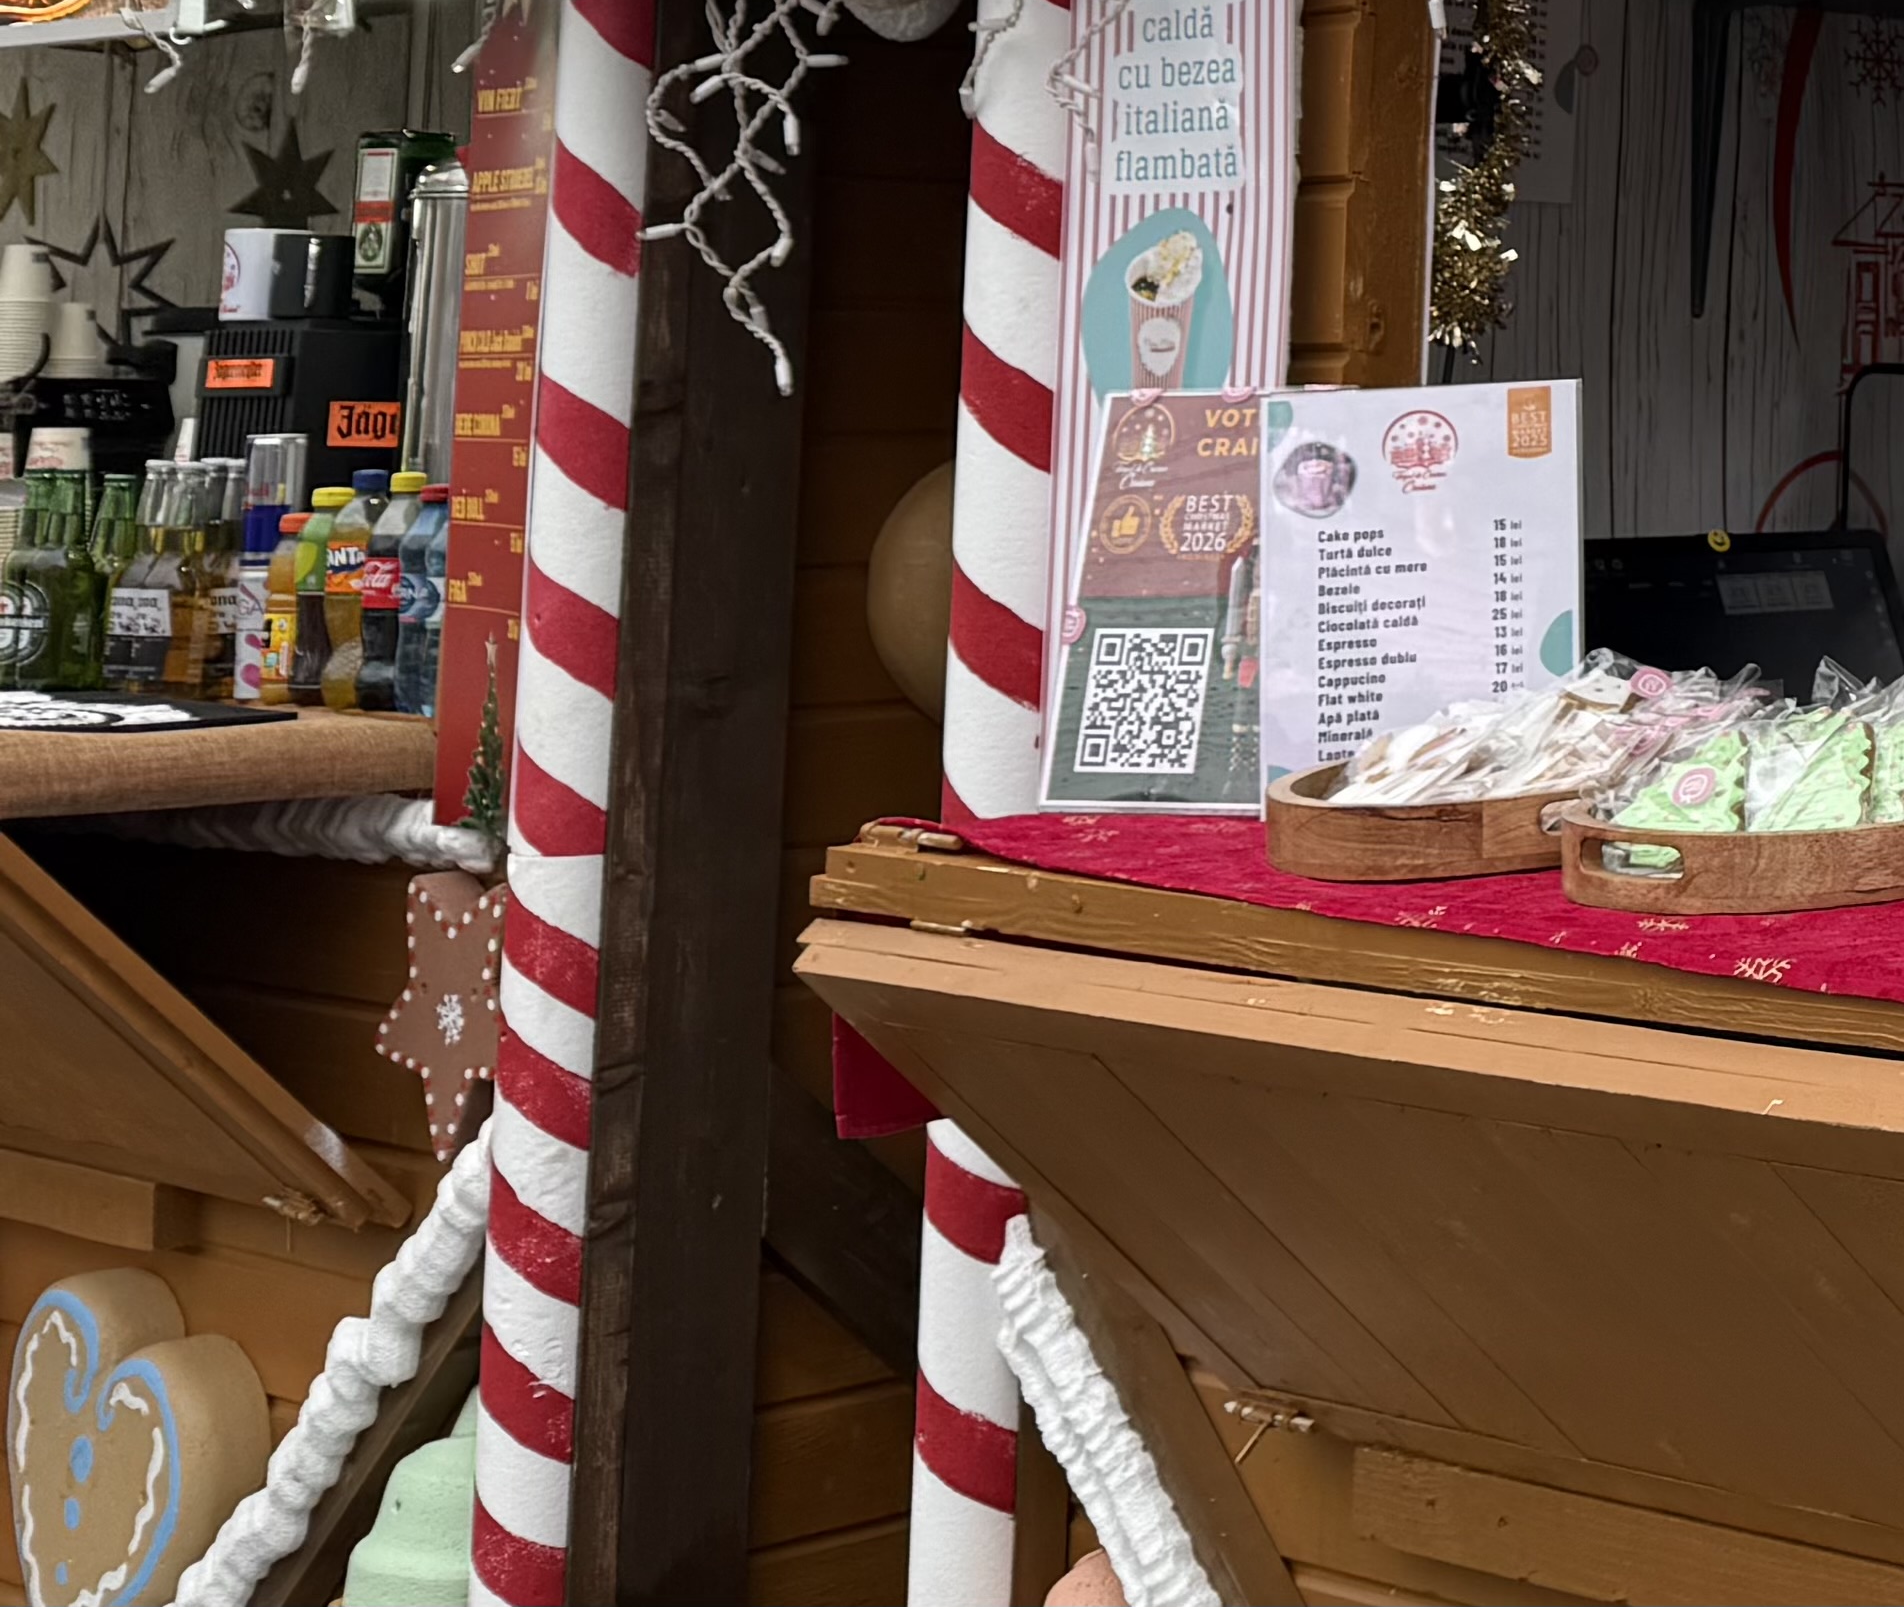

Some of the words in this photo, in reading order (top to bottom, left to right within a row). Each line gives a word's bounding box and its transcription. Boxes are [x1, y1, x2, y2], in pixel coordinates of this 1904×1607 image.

[1142, 5, 1214, 43] caldă
[1118, 63, 1151, 91] cu
[1161, 56, 1236, 88] bezea
[1124, 98, 1230, 136] italiană
[1115, 145, 1239, 182] flambată
[1205, 409, 1257, 429] VOT
[1185, 494, 1235, 513] BEST
[1493, 518, 1507, 531] 15
[1180, 532, 1227, 552] 2026
[1317, 530, 1350, 543] Cake
[1353, 529, 1385, 543] pops
[327, 546, 366, 567] ANTA
[1318, 546, 1353, 561] Turtă
[1357, 545, 1393, 558] dulce
[1493, 554, 1508, 567] 15
[1317, 564, 1372, 579] Plăcintă
[1375, 564, 1391, 575] cu
[1394, 562, 1428, 574] mere
[1493, 572, 1508, 585] 14
[1317, 584, 1361, 597] Bezele
[1491, 608, 1508, 621] 25
[1317, 617, 1380, 633] Ciocolată
[1383, 615, 1419, 629] caldă
[1494, 626, 1508, 639] 13
[1317, 638, 1378, 653] Espresso
[1494, 644, 1508, 657] 16
[1317, 656, 1378, 671] Espresso
[1381, 652, 1417, 666] dublu
[1495, 662, 1508, 675] 17
[1317, 673, 1387, 690] Cappucino
[1491, 680, 1508, 693] 20
[1317, 693, 1343, 707] Flat
[1346, 691, 1384, 704] white
[1317, 711, 1343, 727] Apă
[1346, 709, 1380, 725] plată
